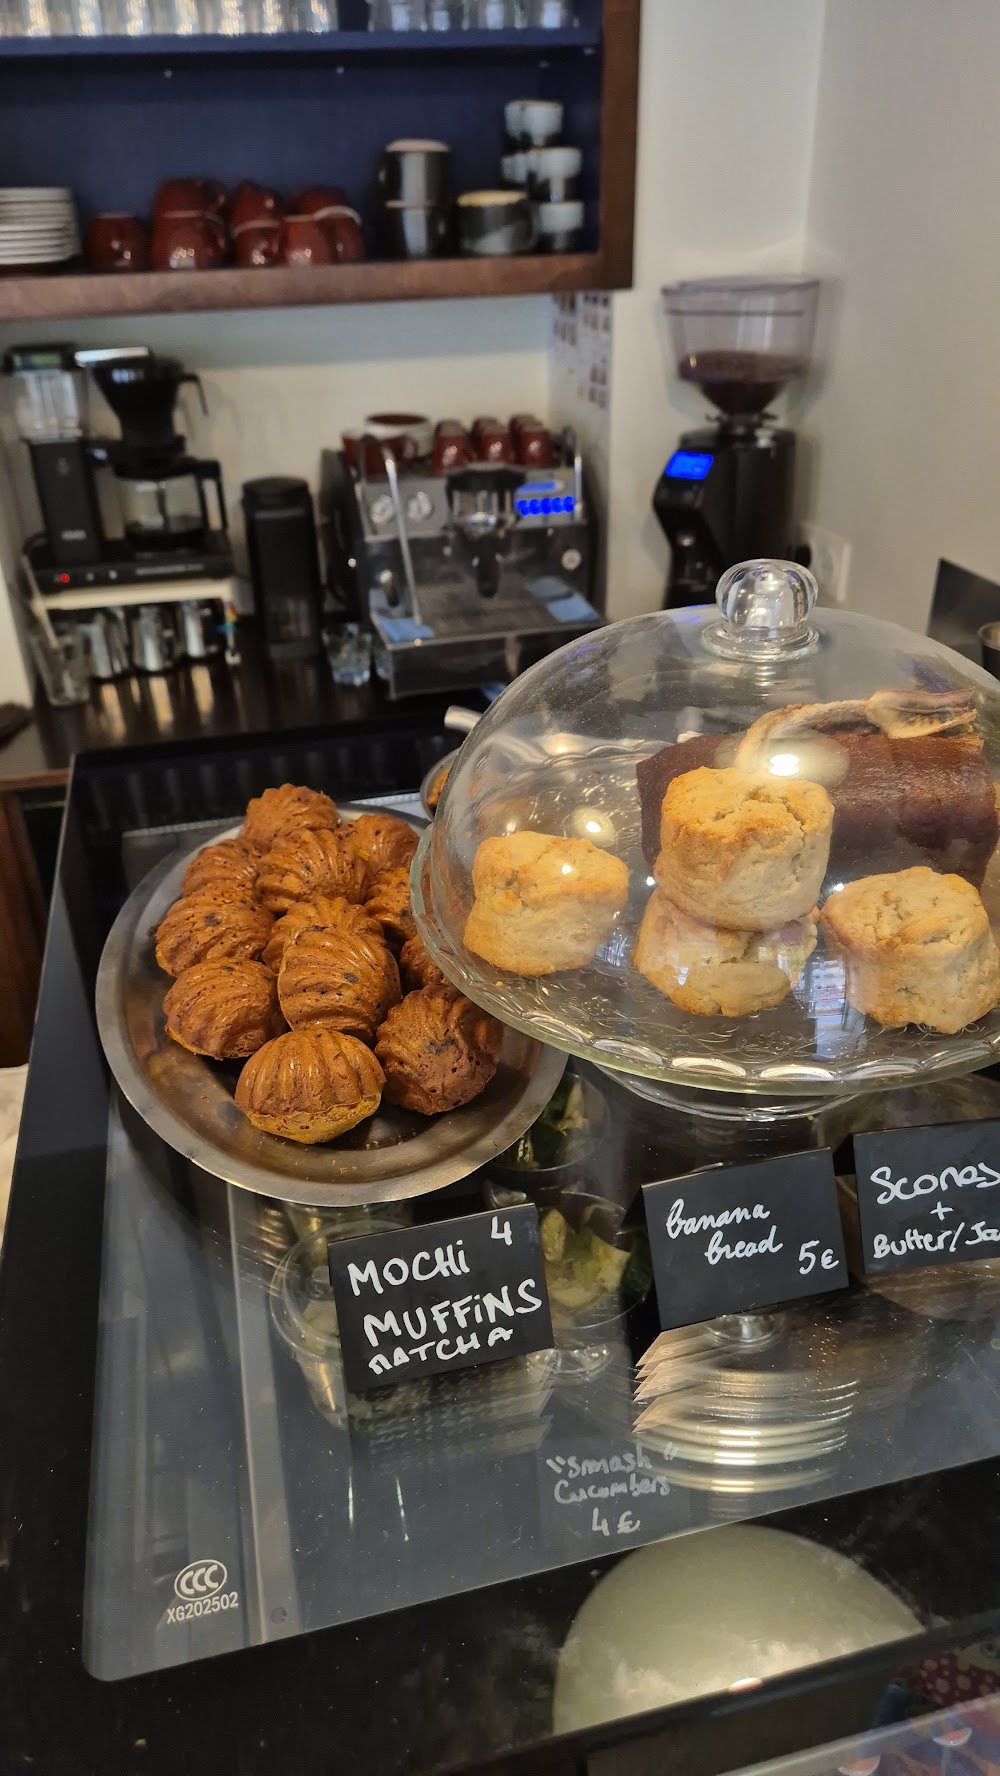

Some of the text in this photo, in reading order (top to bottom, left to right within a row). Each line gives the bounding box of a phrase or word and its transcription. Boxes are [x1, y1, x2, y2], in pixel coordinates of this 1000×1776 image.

[870, 1162, 1000, 1204] Scones
[666, 1199, 770, 1239] banana
[930, 1201, 954, 1220] +
[491, 1216, 513, 1246] 4
[704, 1225, 783, 1265] bread
[873, 1221, 1000, 1259] Butter/Ja
[799, 1240, 839, 1275] 5€
[166, 1591, 239, 1624] XG202502
